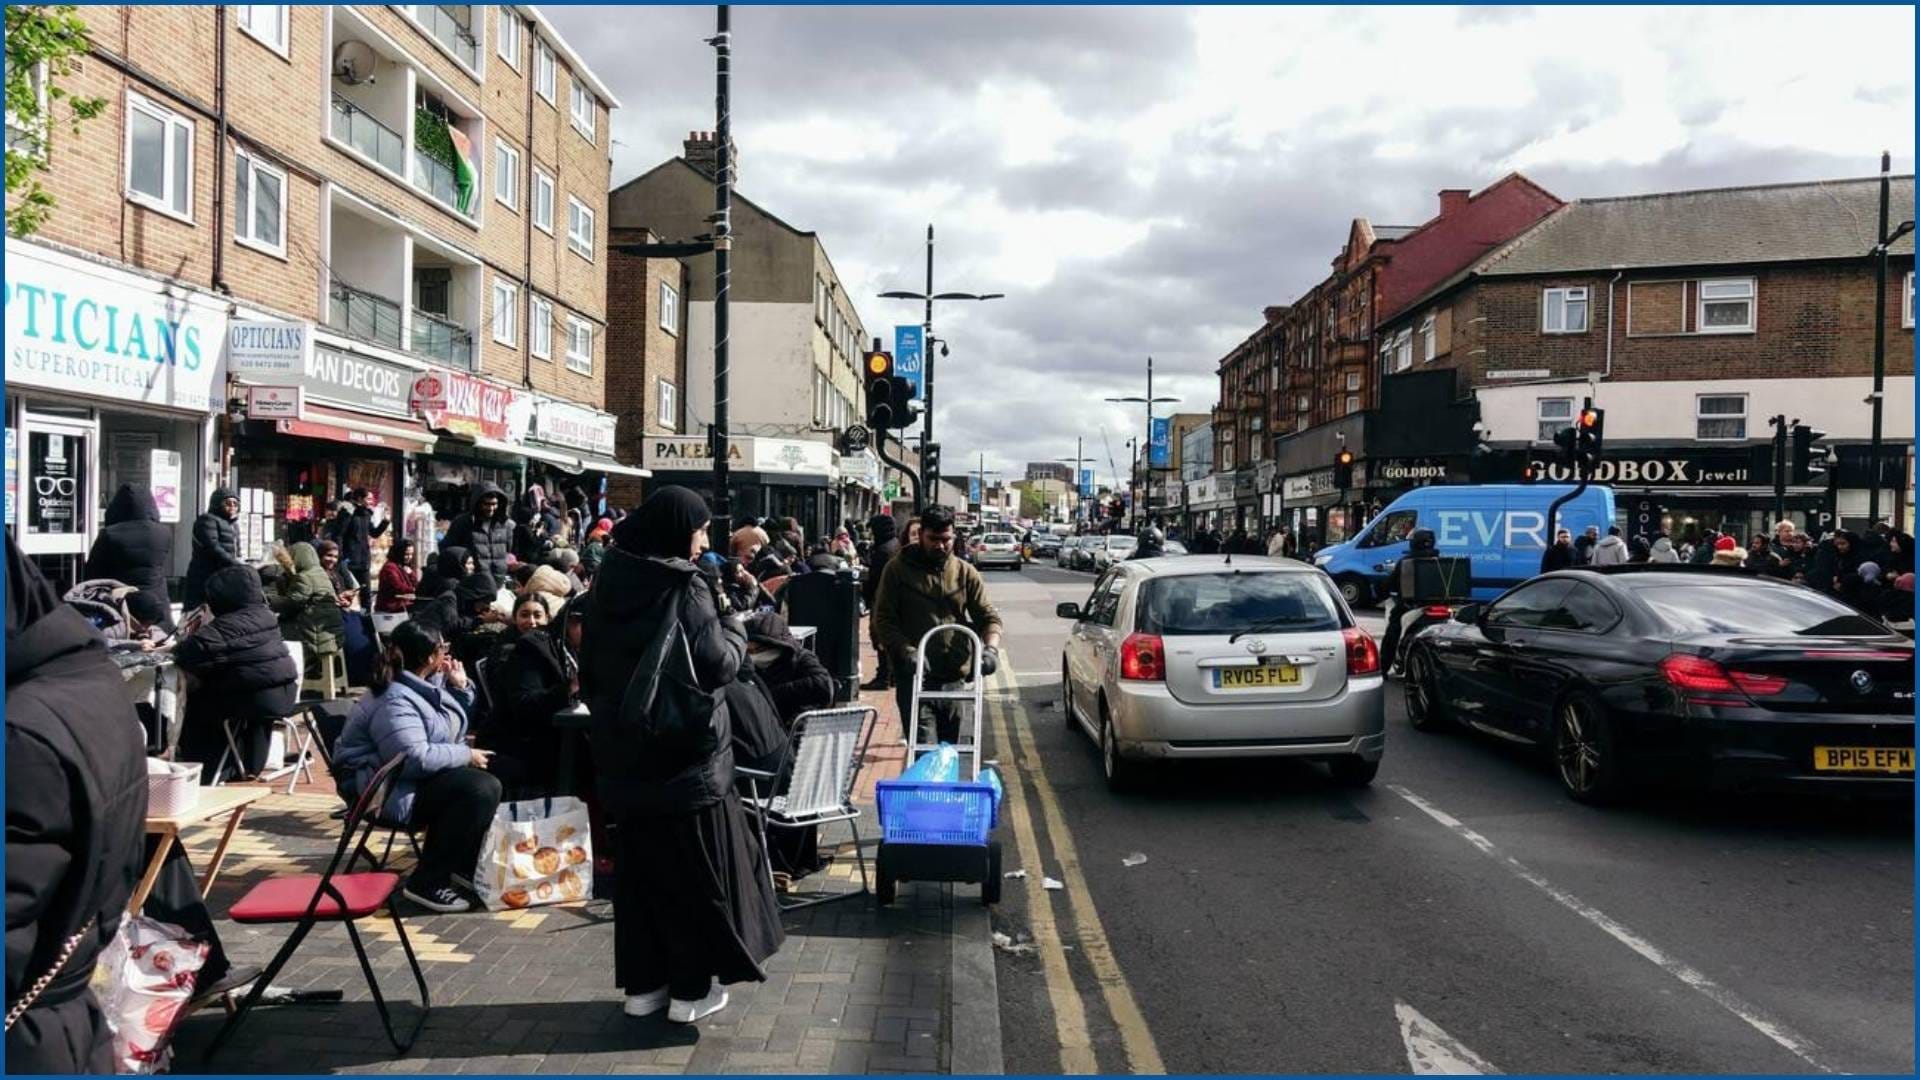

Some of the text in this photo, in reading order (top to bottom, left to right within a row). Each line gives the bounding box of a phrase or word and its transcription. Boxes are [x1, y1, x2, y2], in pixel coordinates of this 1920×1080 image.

[5, 281, 201, 371] TICIANS
[232, 326, 301, 350] OPTICIANS
[13, 346, 153, 390] SUPEROPTICAL
[342, 359, 400, 397] DECORS
[1386, 466, 1446, 478] GOLDBOX
[1696, 468, 1748, 483] Jewell
[1223, 668, 1299, 684] RV05 FLJ
[1827, 749, 1910, 767] BP15 EFM
